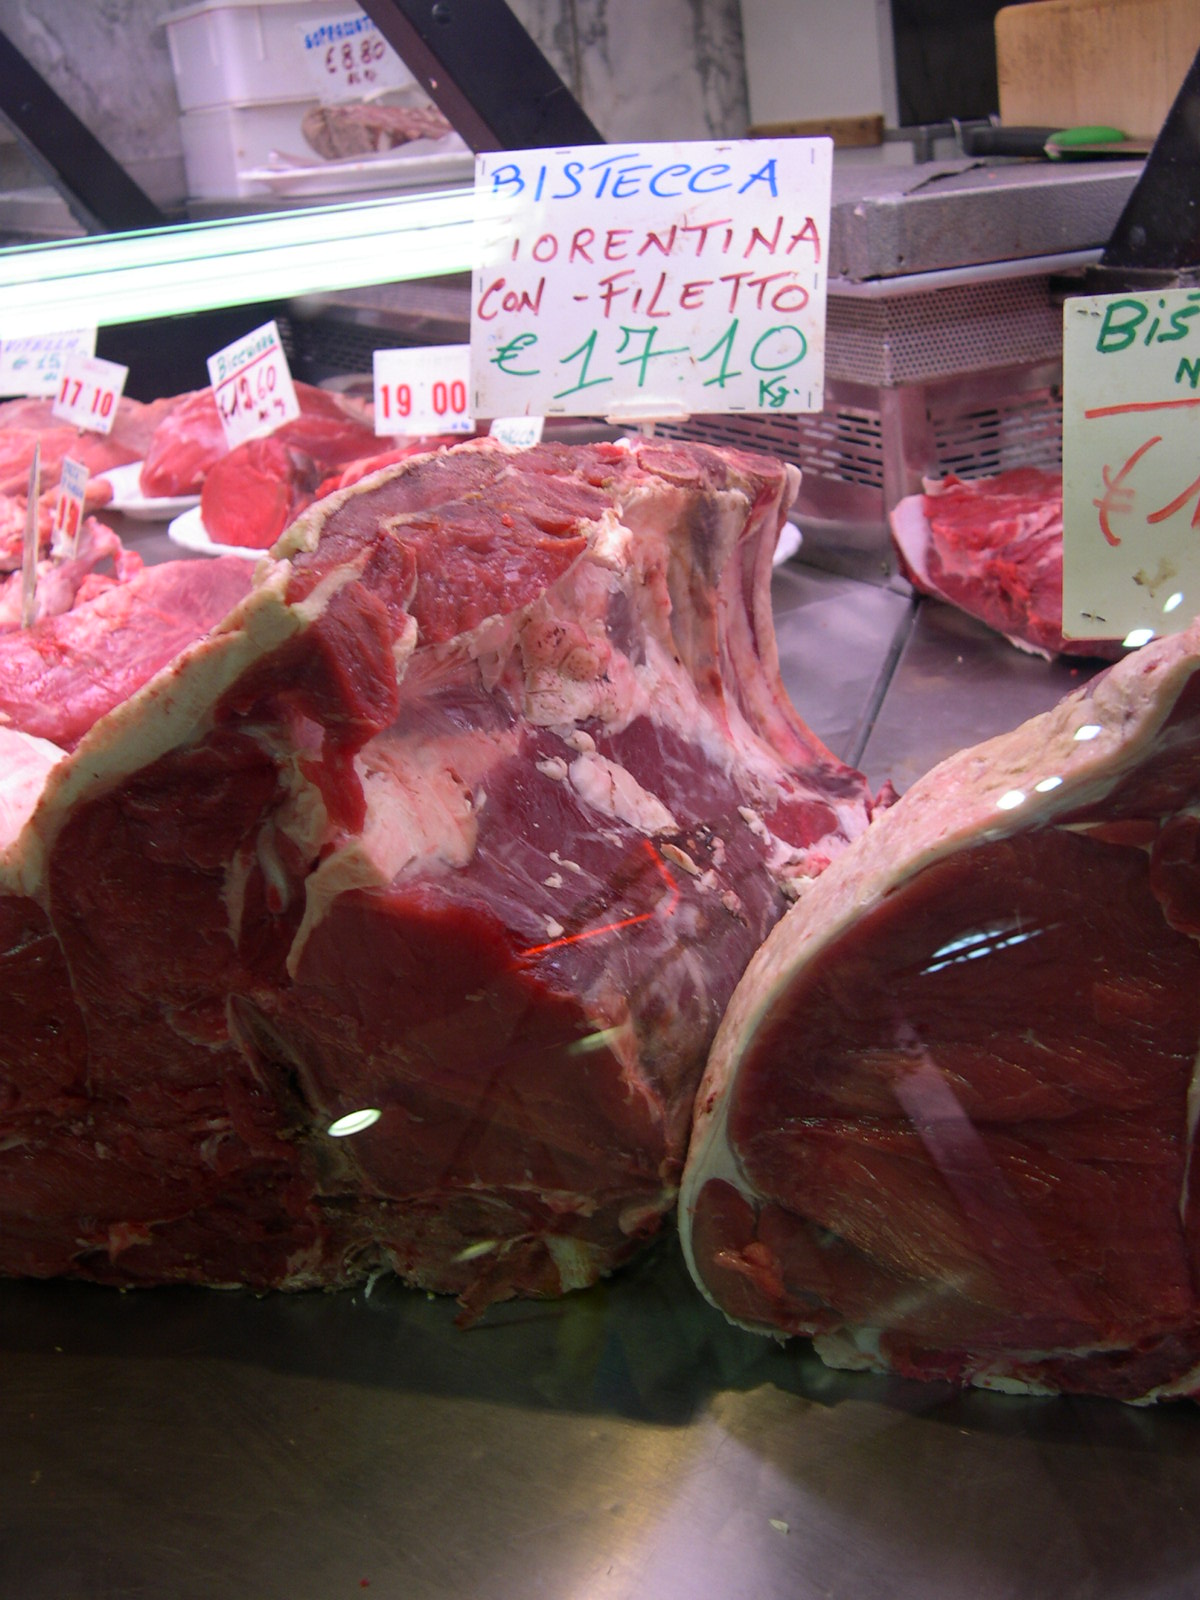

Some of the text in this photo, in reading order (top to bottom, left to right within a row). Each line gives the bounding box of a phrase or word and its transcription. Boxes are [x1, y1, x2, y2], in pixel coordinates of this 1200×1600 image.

[491, 153, 779, 202] BISTECCA
[483, 215, 822, 264] IORENTINA
[477, 277, 546, 321] CON
[1096, 292, 1200, 353] BiS
[489, 332, 541, 376] €
[59, 376, 115, 418] 17 10
[380, 379, 467, 419] 19 00
